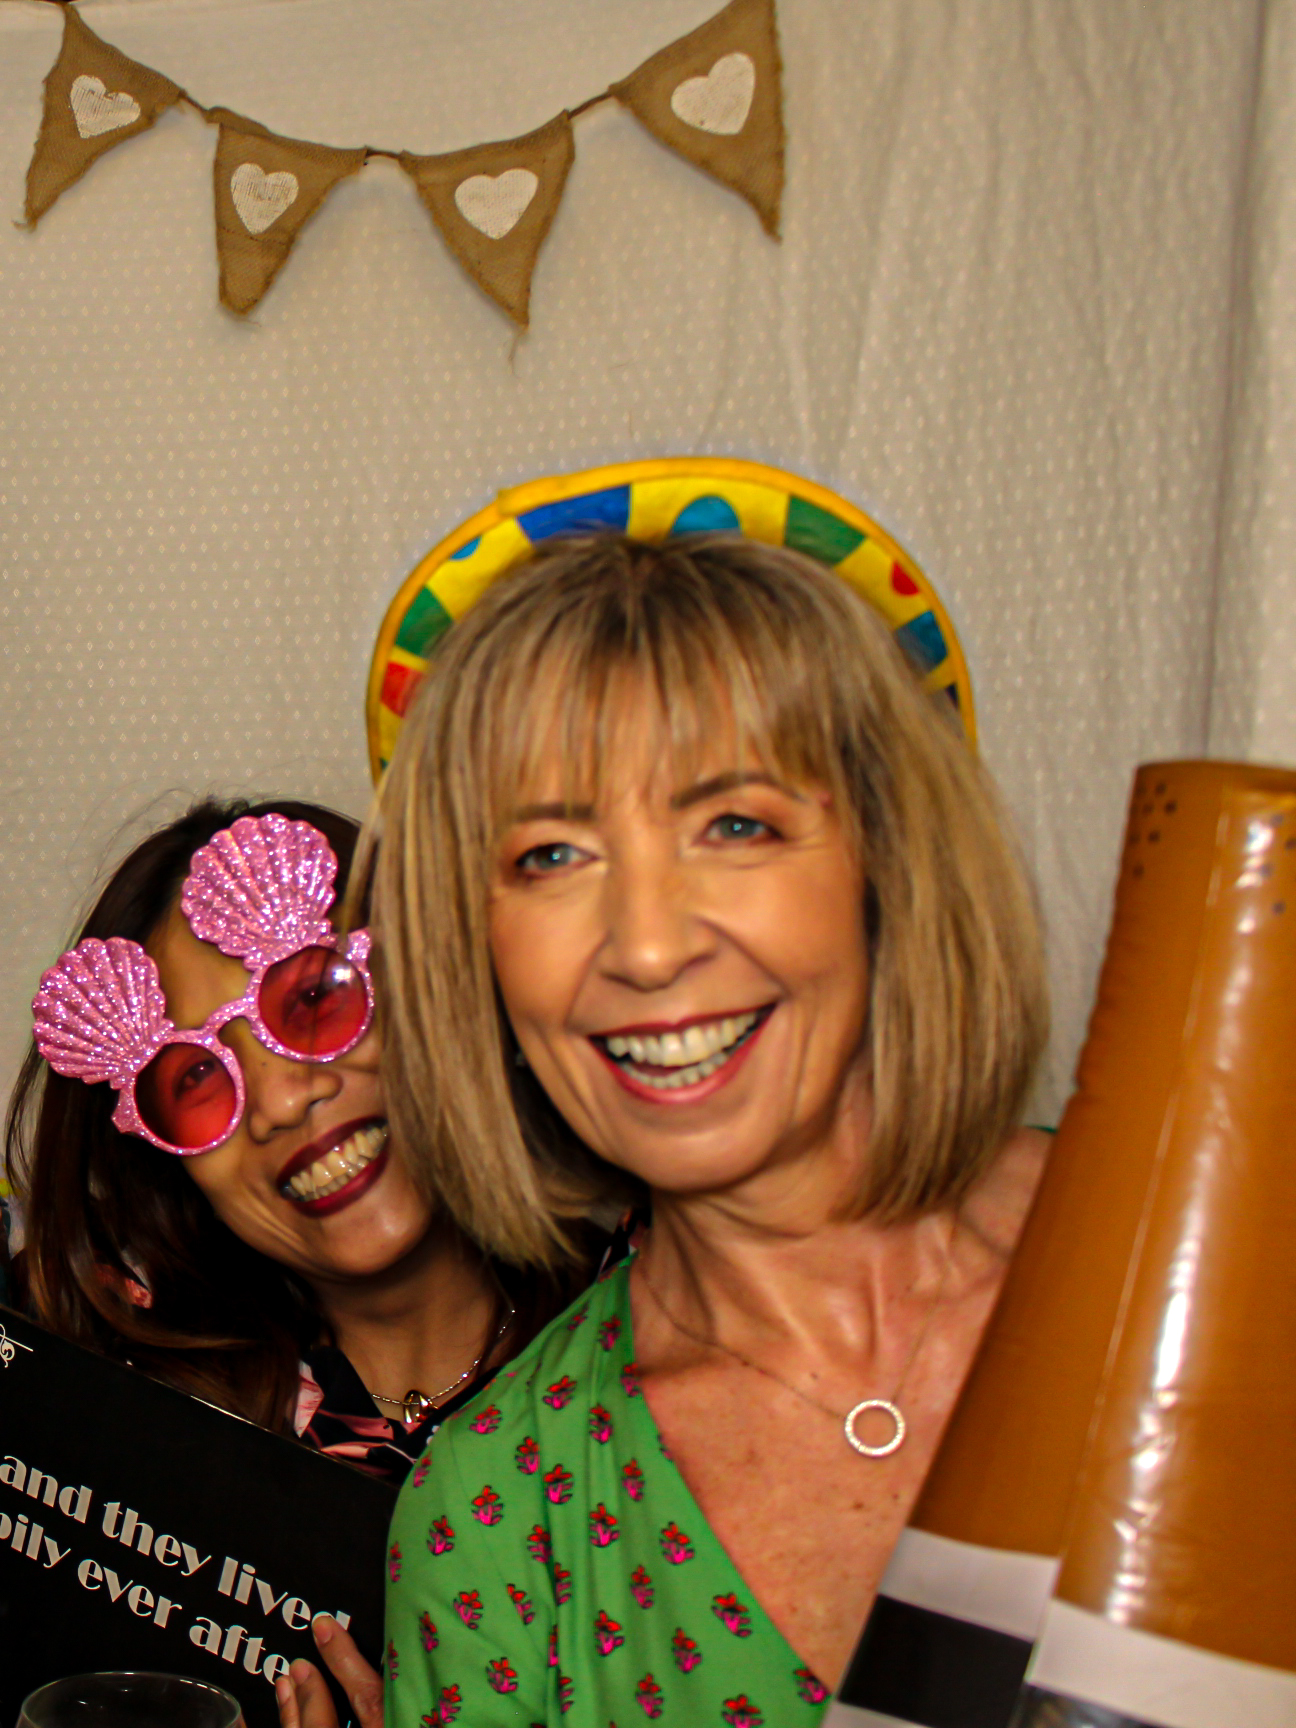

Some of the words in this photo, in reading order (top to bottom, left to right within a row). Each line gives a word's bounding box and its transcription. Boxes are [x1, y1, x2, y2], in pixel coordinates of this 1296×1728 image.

[102, 1501, 212, 1576] they
[77, 1558, 183, 1629] ever
[188, 1616, 292, 1686] afte
